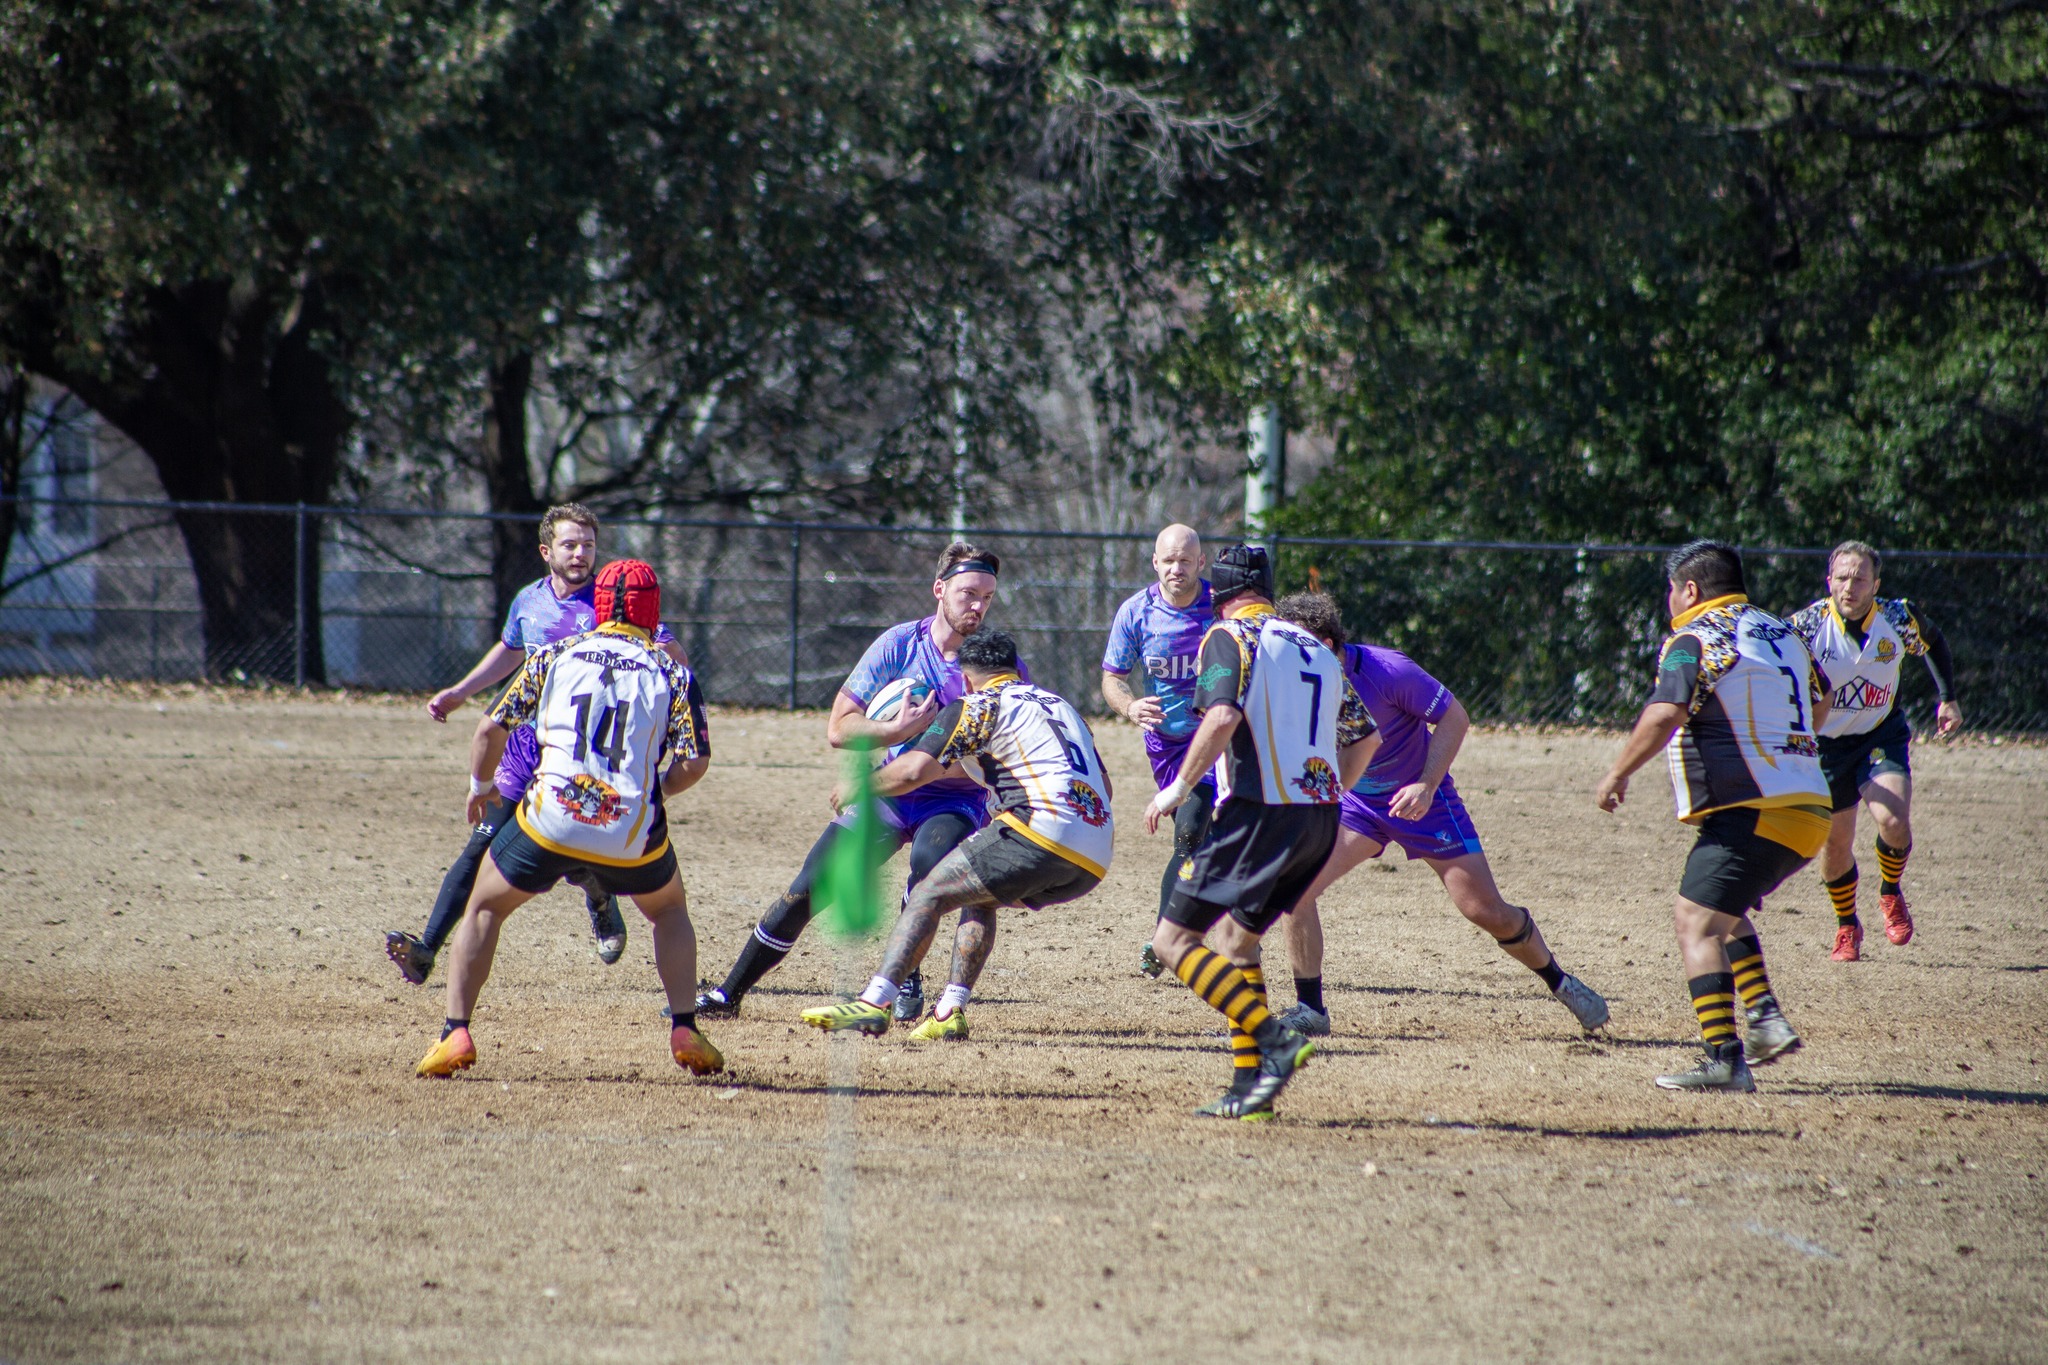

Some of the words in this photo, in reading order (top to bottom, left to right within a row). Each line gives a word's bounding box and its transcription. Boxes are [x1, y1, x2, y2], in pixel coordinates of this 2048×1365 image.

[585, 651, 637, 670] BEDLAM
[1299, 671, 1322, 746] 7
[1777, 666, 1806, 731] 3
[570, 693, 630, 773] 14
[1047, 718, 1089, 776] 6
